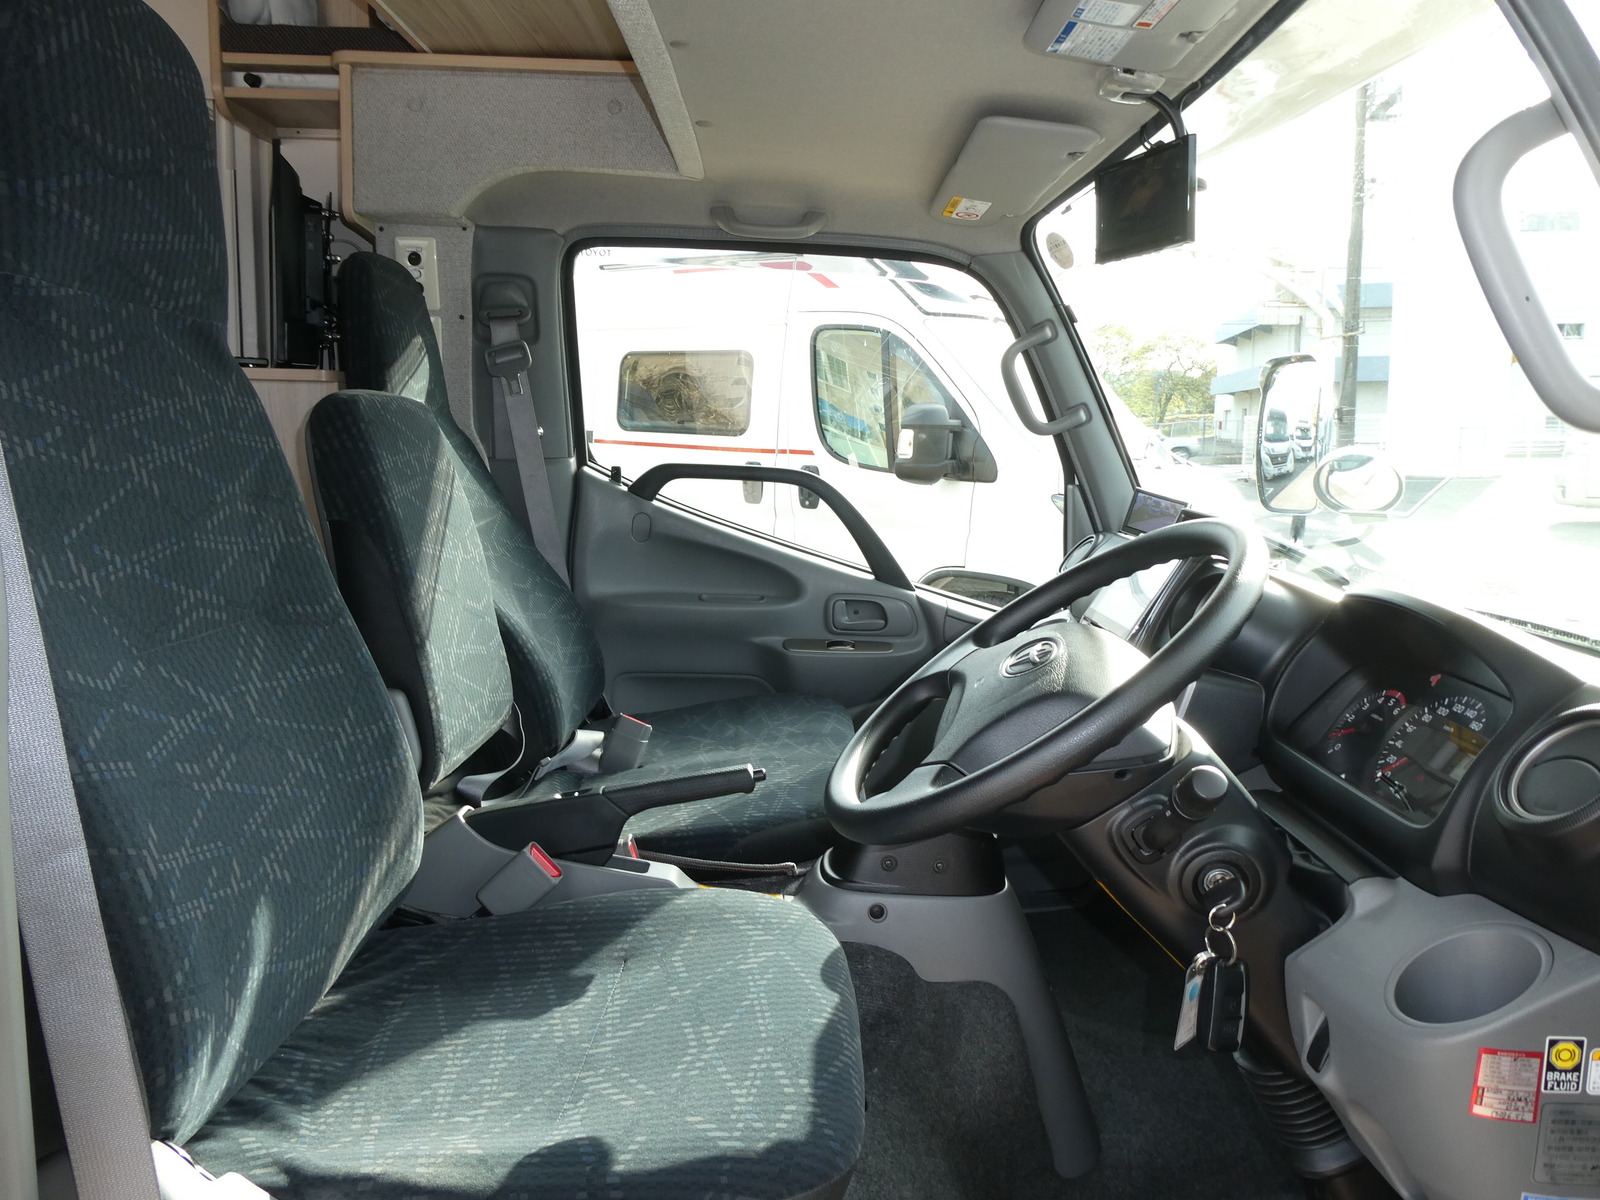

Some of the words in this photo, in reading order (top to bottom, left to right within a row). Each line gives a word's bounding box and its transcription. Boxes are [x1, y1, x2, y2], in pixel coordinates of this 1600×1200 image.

[1388, 698, 1396, 706] 5
[1392, 707, 1401, 715] 6
[1452, 703, 1465, 713] 120
[1468, 720, 1483, 731] 160
[1546, 1071, 1580, 1082] BRAKE
[1547, 1081, 1578, 1091] FLUID
